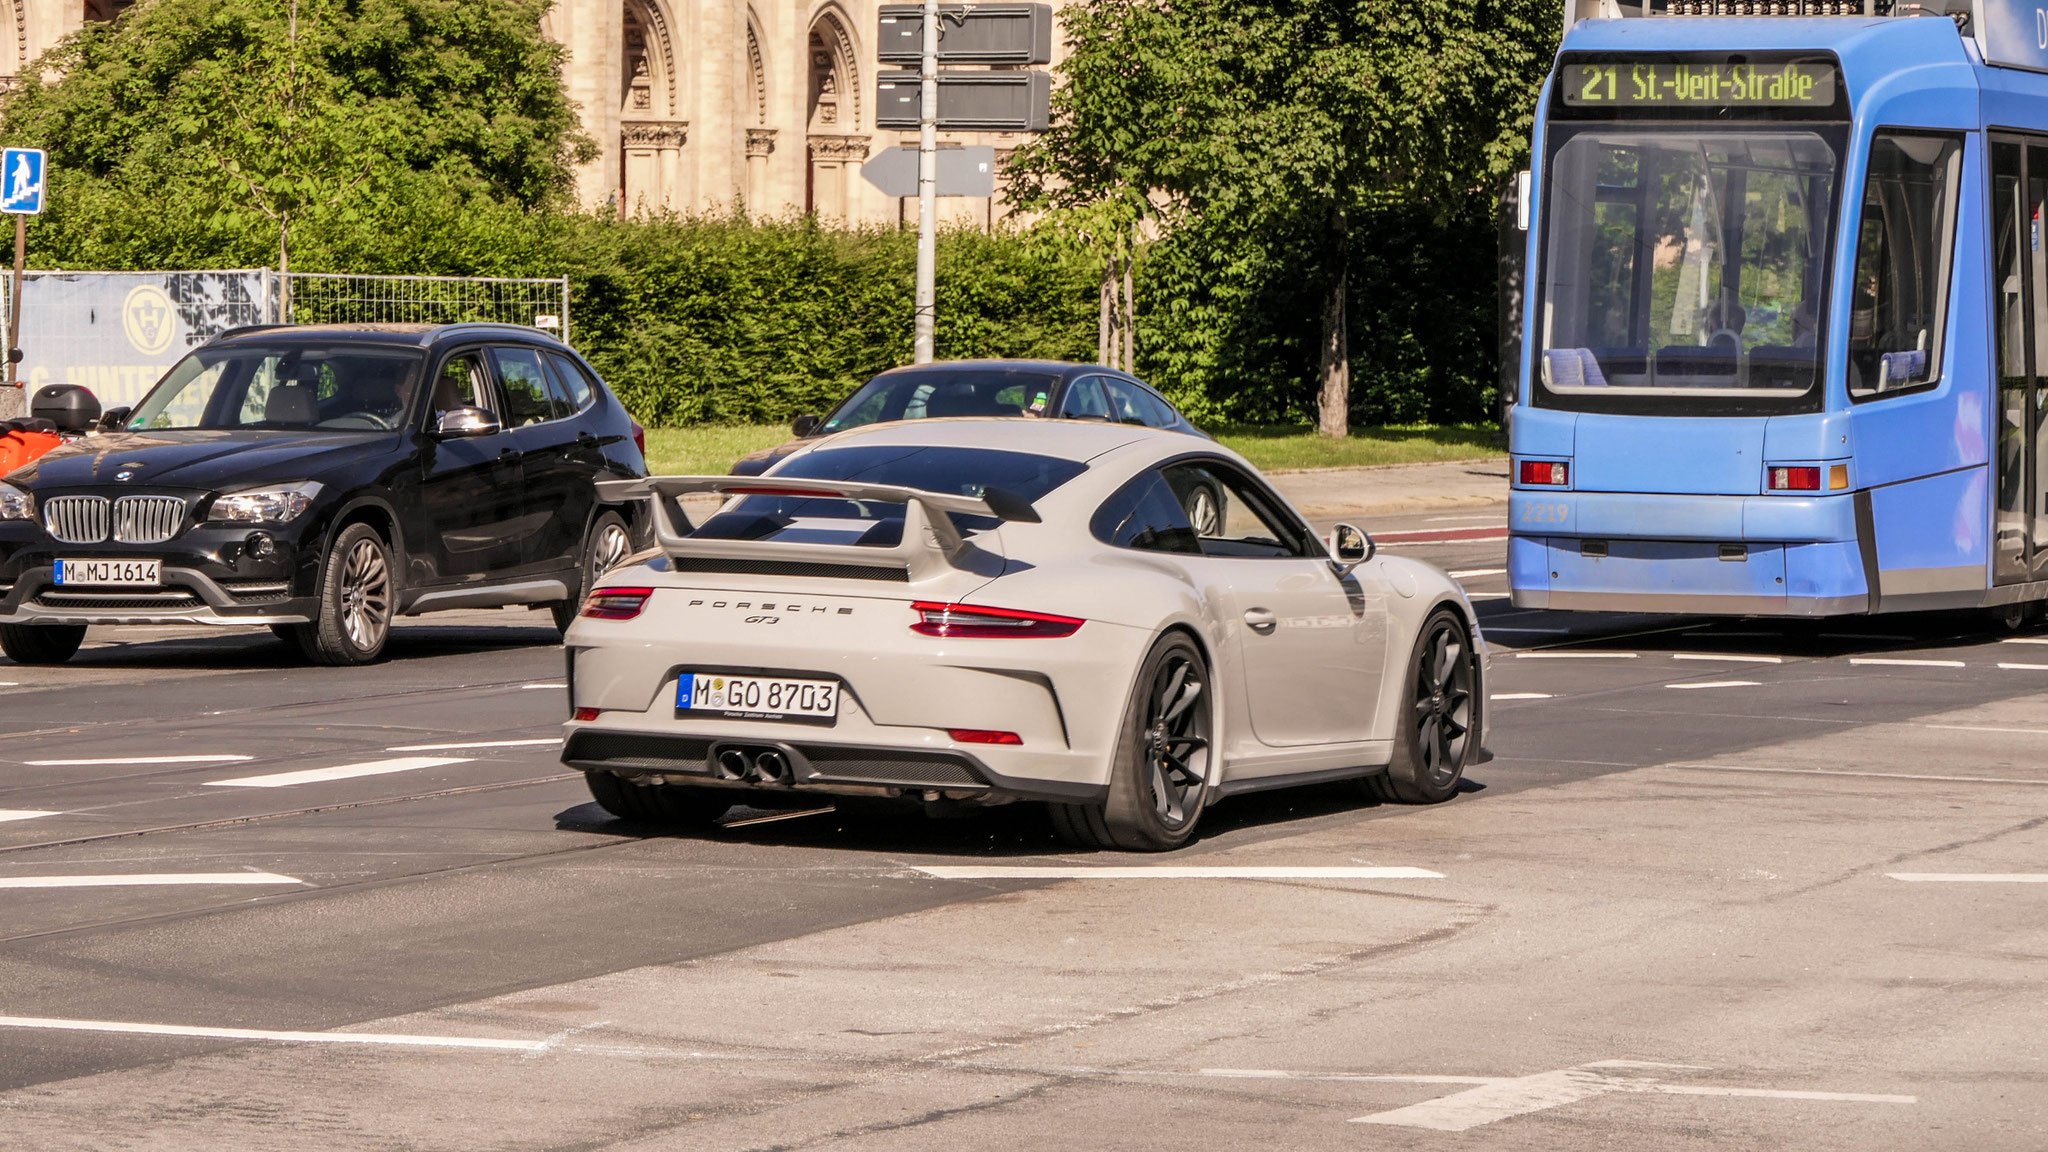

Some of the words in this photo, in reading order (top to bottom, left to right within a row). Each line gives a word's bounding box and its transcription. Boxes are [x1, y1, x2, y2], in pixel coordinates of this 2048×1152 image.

[2036, 8, 2048, 50] D
[1581, 64, 1617, 101] 21
[1632, 63, 1813, 101] St.-Veit-Straße
[1522, 503, 1569, 523] 2219
[64, 563, 75, 581] M
[689, 600, 853, 615] PORSCHE
[744, 615, 781, 625] GT3
[694, 678, 711, 705] M
[728, 680, 760, 708] GO
[768, 682, 834, 712] 8703
